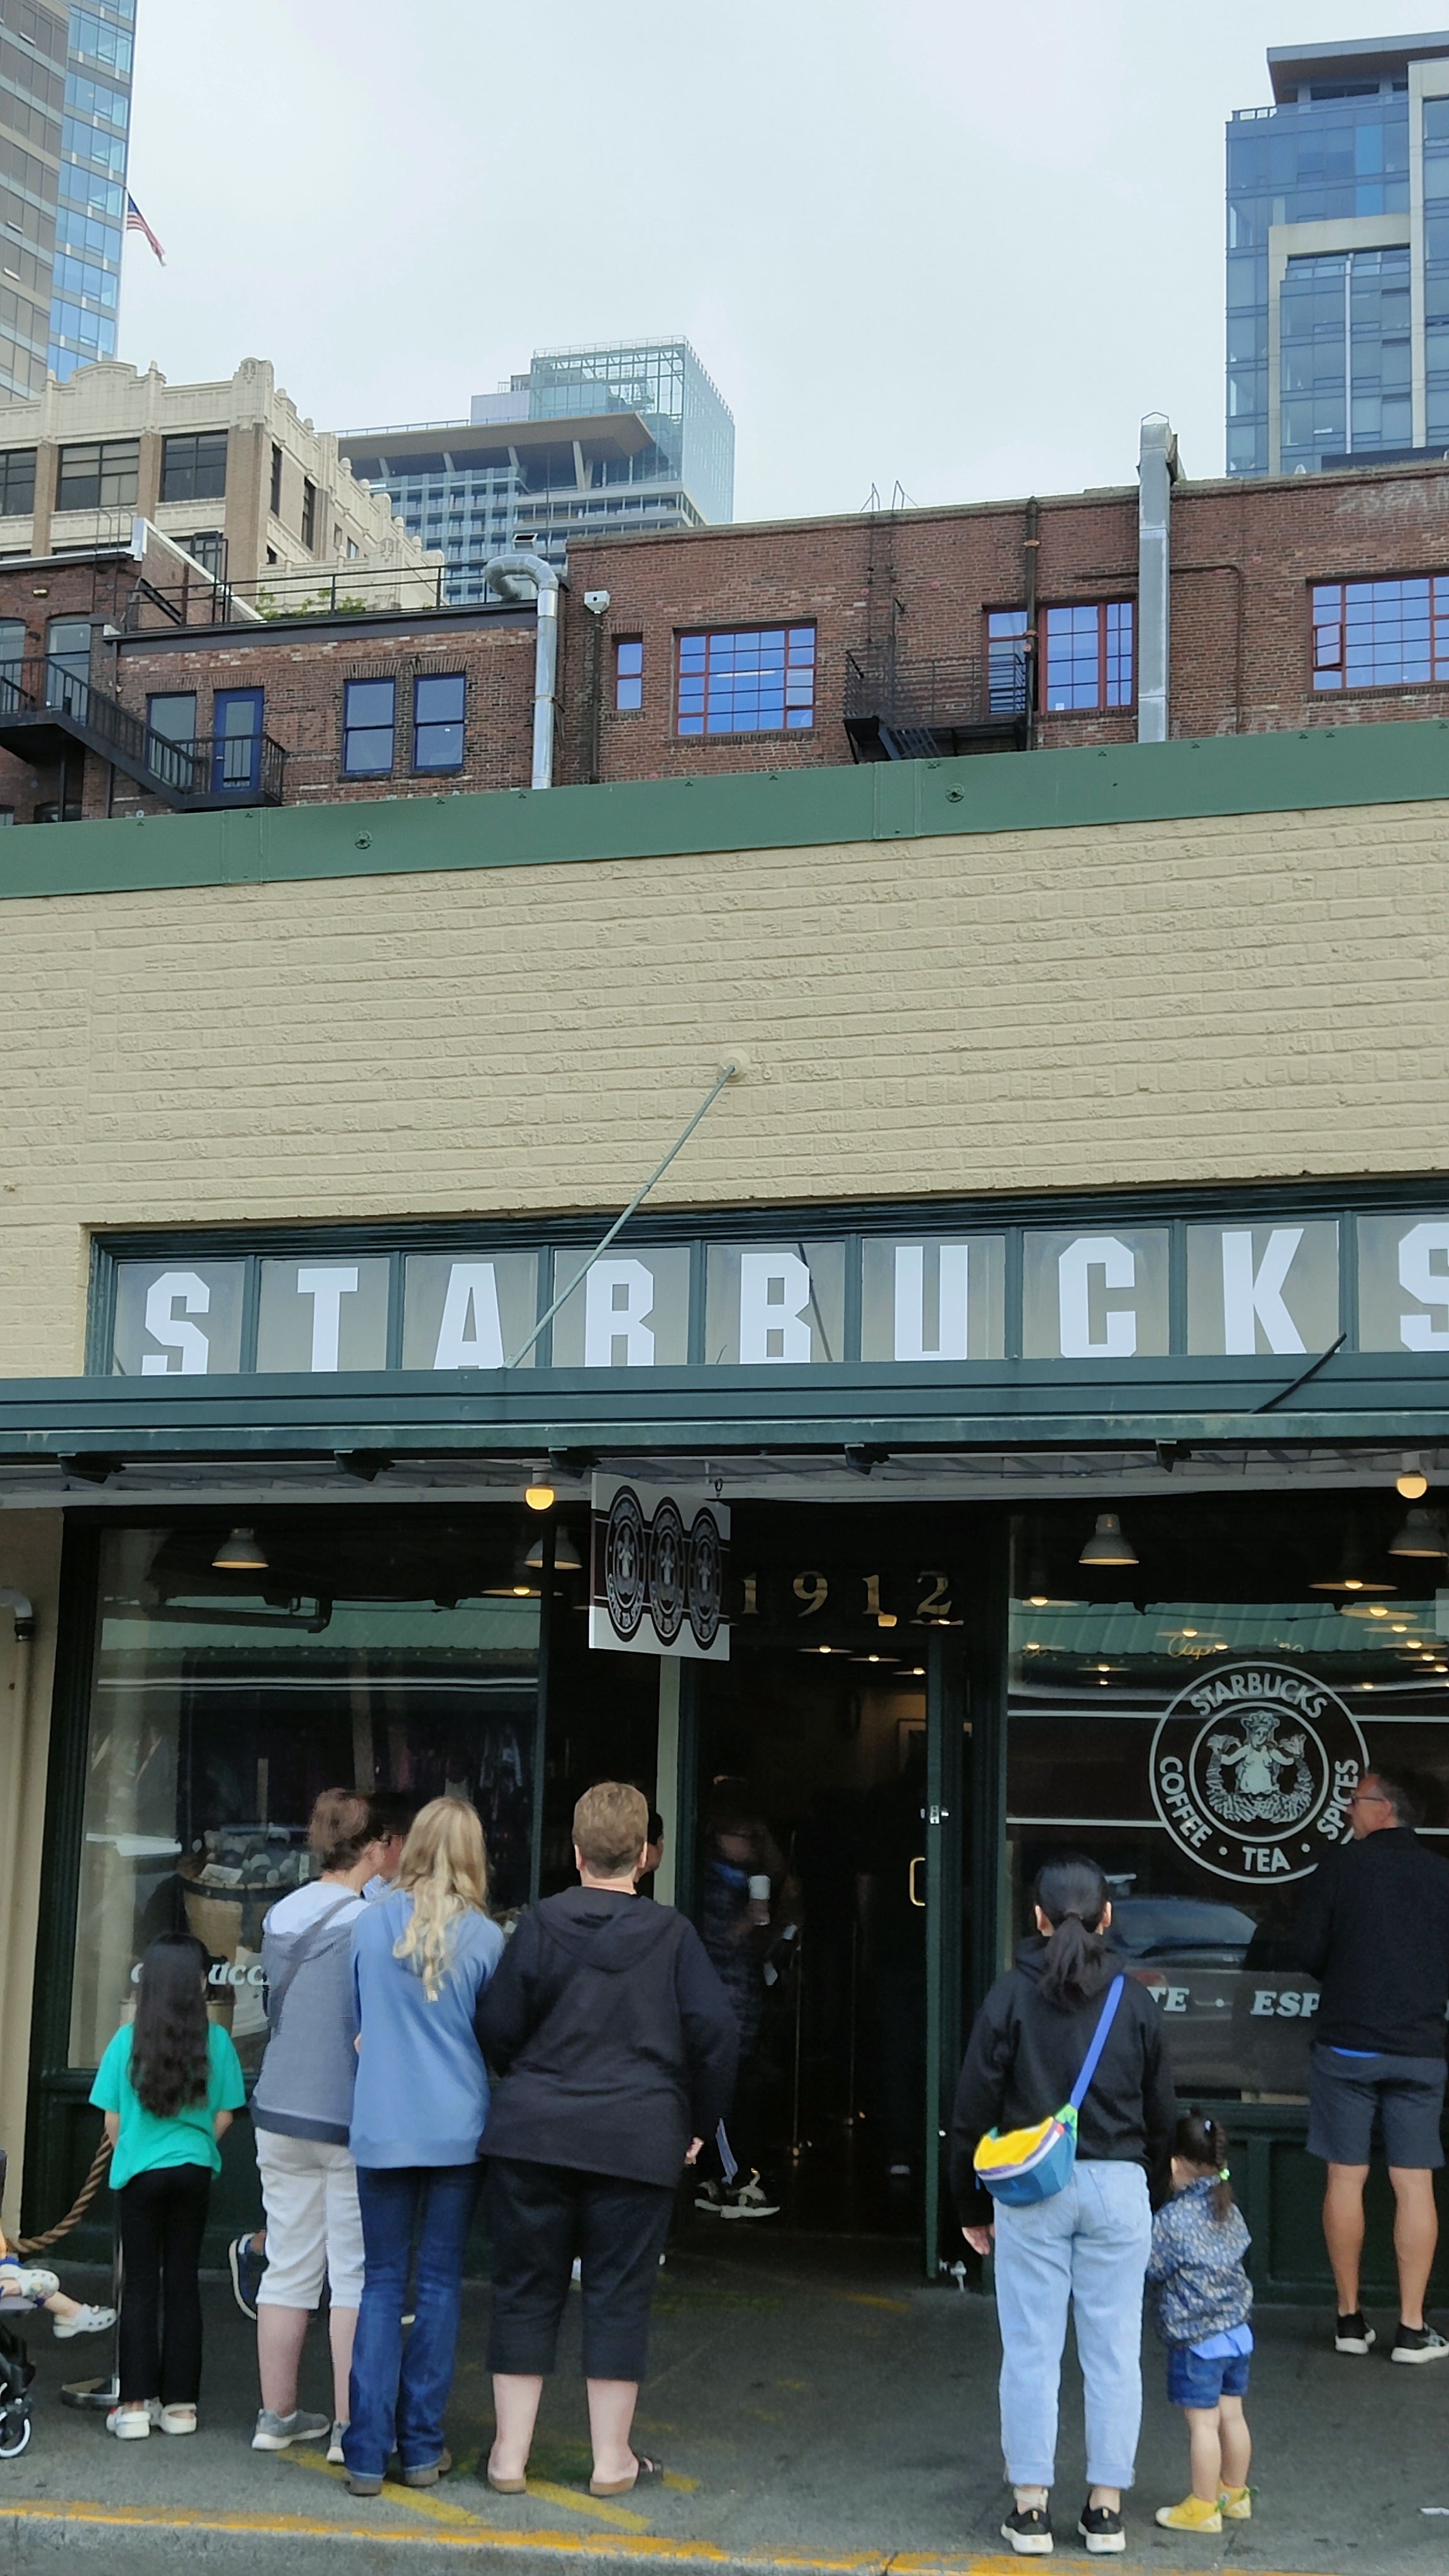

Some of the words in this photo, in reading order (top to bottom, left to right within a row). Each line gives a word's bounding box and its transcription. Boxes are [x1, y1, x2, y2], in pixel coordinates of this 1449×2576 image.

[142, 1222, 1449, 1376] STARBUCKS
[1191, 1672, 1328, 1718] STARBUCKS
[1158, 1756, 1213, 1848] COFFEE
[1242, 1846, 1291, 1872] TEA
[1316, 1759, 1359, 1840] SPICES
